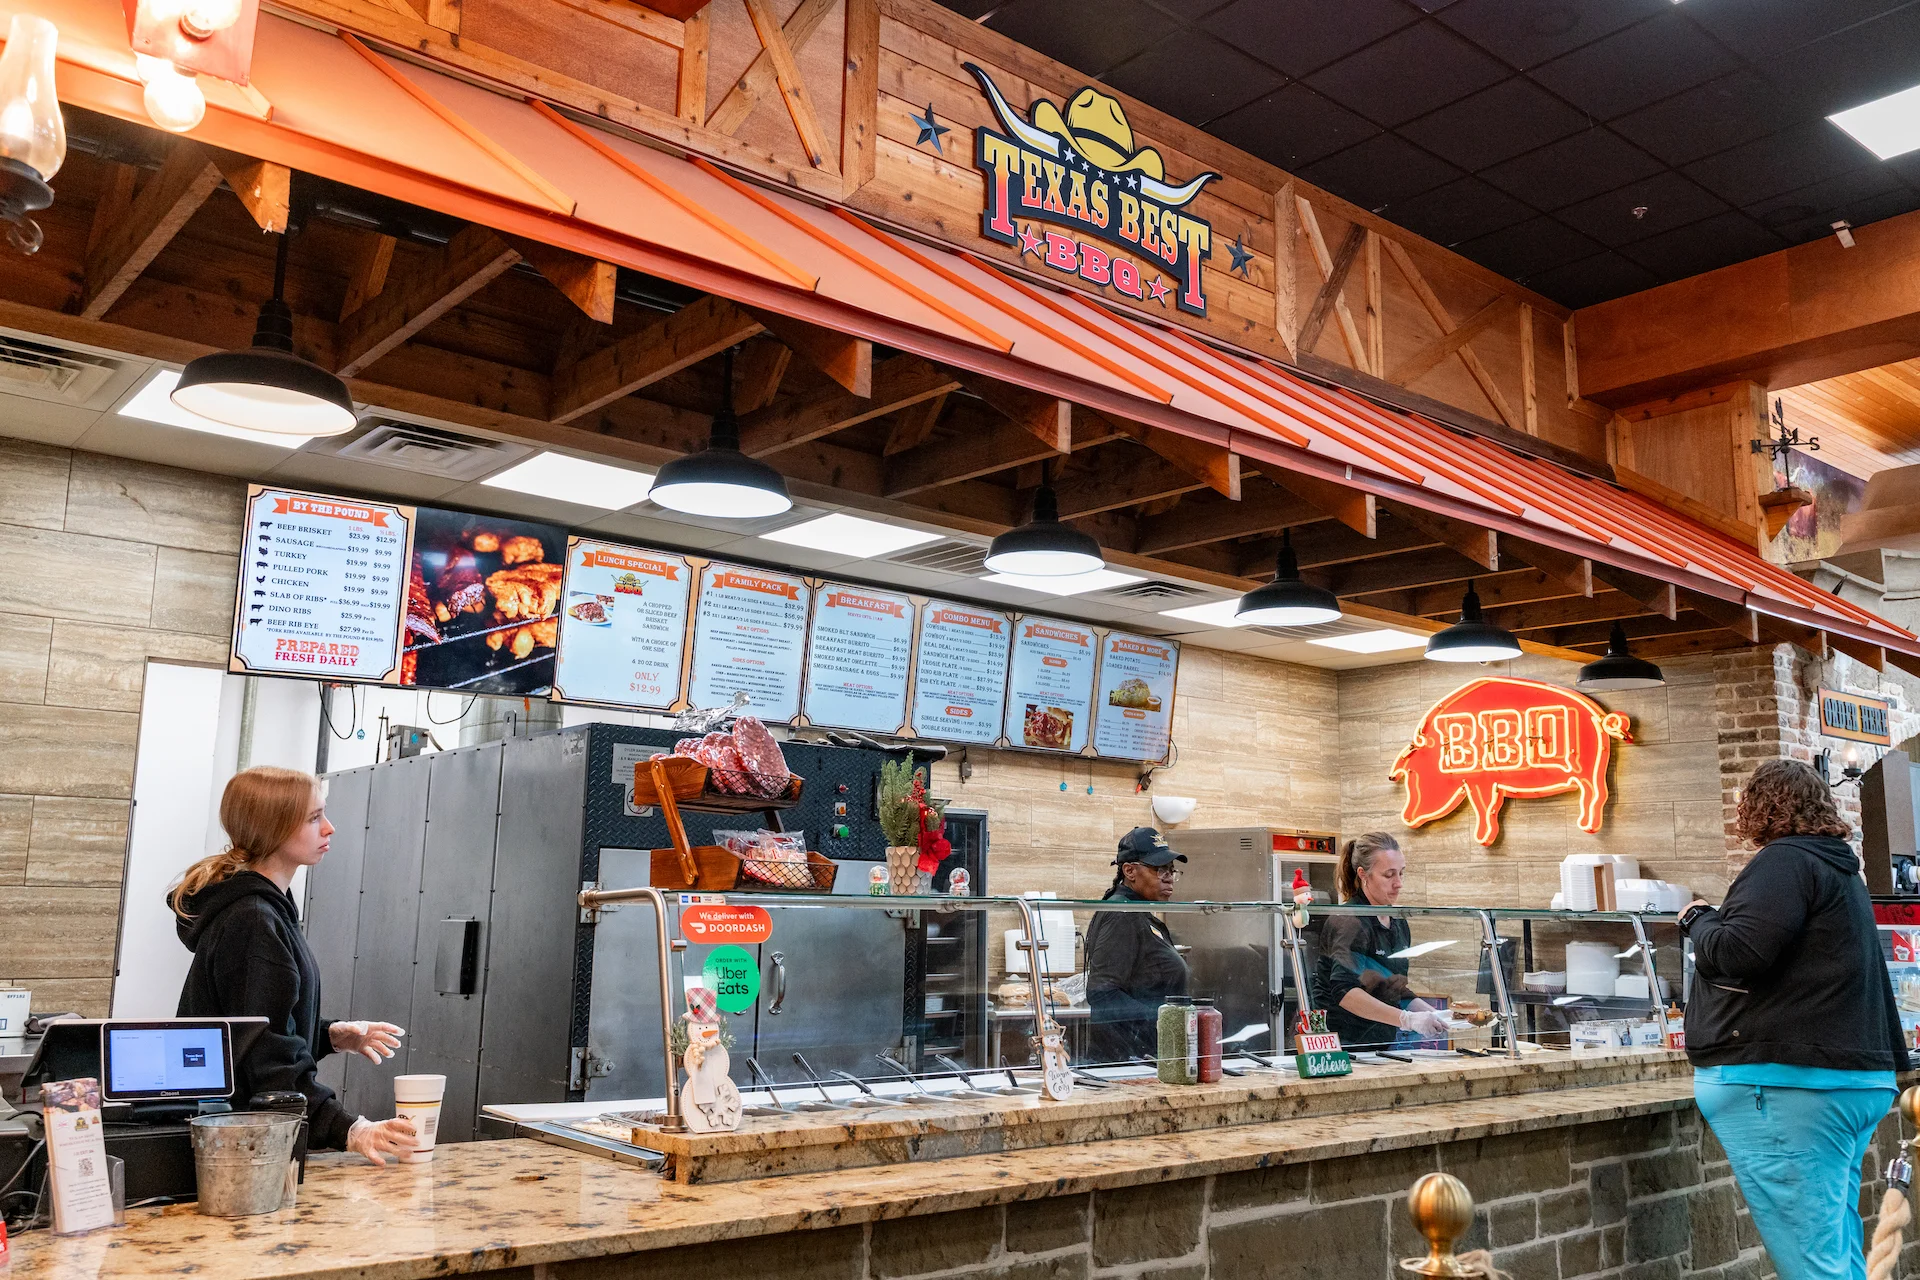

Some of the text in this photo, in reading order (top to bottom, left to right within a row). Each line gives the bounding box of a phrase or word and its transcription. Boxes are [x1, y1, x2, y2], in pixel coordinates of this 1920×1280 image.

[983, 133, 1210, 310] TEXAS BEST
[1044, 231, 1144, 299] BBQ
[293, 501, 370, 519] BY THE POUND
[298, 526, 332, 536] BRISKET
[276, 537, 314, 547] SAUSAGE
[349, 532, 396, 544] $23.99 $12.99
[274, 550, 308, 560] TURKEY
[348, 546, 368, 554] $19.99
[346, 559, 390, 570] $19.99 $9.99
[597, 555, 663, 572] LUNCH SPECIAL
[273, 564, 328, 576] PULLED PORK
[271, 578, 309, 588] CHICKEN
[345, 572, 389, 583] $19.99 $9.99
[729, 577, 782, 591] FAMILY PACK
[370, 588, 388, 596] $9.99
[270, 591, 291, 599] SLAB
[338, 598, 360, 606] $36.99
[840, 596, 890, 611] BREAKFAST
[648, 602, 672, 610] CHOPPED
[268, 605, 362, 620] DINO RIBS $25.99
[644, 608, 663, 616] SLICED
[267, 619, 287, 627] BEEF
[645, 616, 667, 624] BRISKET
[943, 613, 990, 626] COMBO MENU
[642, 623, 669, 631] SANDWICH
[817, 626, 838, 634] SMOKED
[850, 631, 876, 639] SANDWICH
[925, 623, 948, 631] COWGIRL
[1035, 627, 1078, 640] SANDWICHES
[815, 635, 847, 645] BREAKFAST
[925, 632, 1005, 650] COWBOY $19.99
[1020, 640, 1049, 649] SANDWICHES
[276, 638, 360, 657] PREPARED
[815, 644, 846, 654] BREAKFAST
[862, 651, 885, 659] BURRITO
[1119, 642, 1140, 651] BAKED
[275, 651, 358, 666] FRESH DAILY
[923, 650, 948, 659] SANDWICH
[814, 654, 835, 662] SMOKED
[852, 659, 878, 667] OMELETTE
[922, 659, 941, 667] VEGGIE
[1106, 662, 1122, 670] LOADED
[835, 666, 860, 674] SAUSAGE
[634, 672, 659, 681] ONLY
[629, 683, 661, 695] $12.99
[939, 717, 960, 725] SERVING
[1824, 697, 1889, 736] ORDER HERE
[941, 726, 961, 734] SERVING
[1434, 705, 1573, 773] BBQ
[699, 912, 712, 920] We
[713, 911, 737, 920] deliver
[710, 924, 765, 932] DOORDASH
[716, 966, 747, 979] Uber
[717, 982, 749, 995] Eats
[1306, 1035, 1337, 1050] HOPE
[1308, 1053, 1348, 1075] Believe
[1048, 1070, 1070, 1080] Warm
